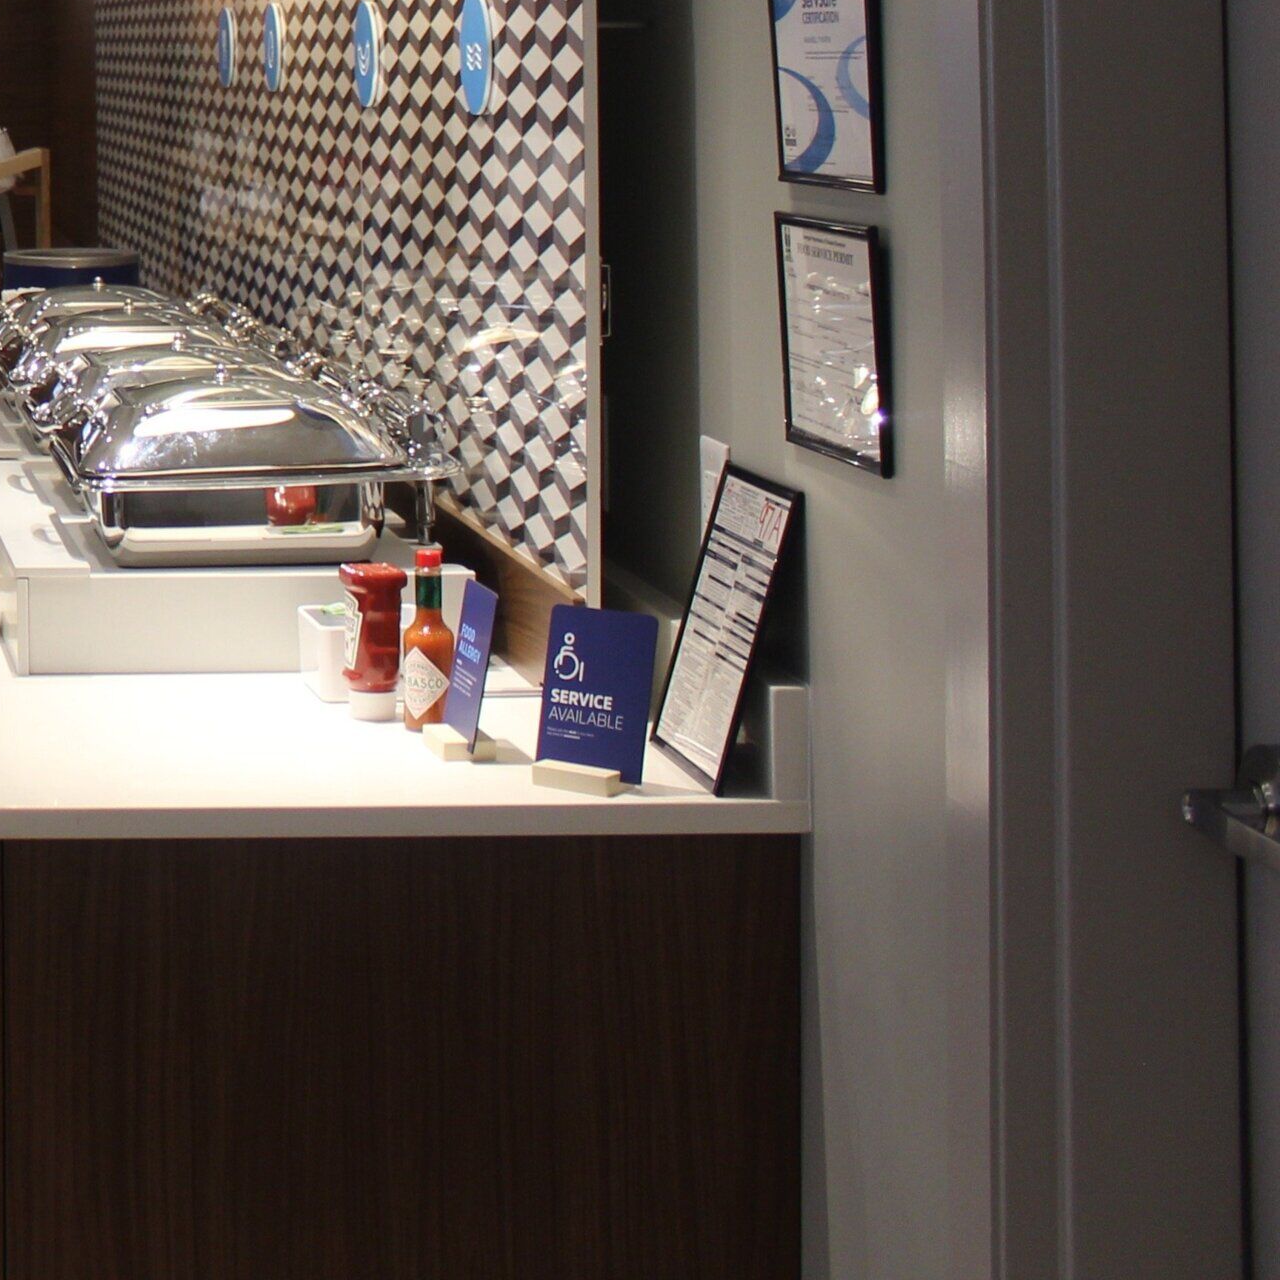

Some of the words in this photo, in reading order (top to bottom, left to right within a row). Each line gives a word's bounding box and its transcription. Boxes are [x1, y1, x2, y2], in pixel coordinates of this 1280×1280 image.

[460, 622, 476, 644] FOOD
[458, 639, 482, 665] ALLERGY
[550, 687, 614, 711] SERVICE
[547, 705, 624, 731] AVAILABLE
